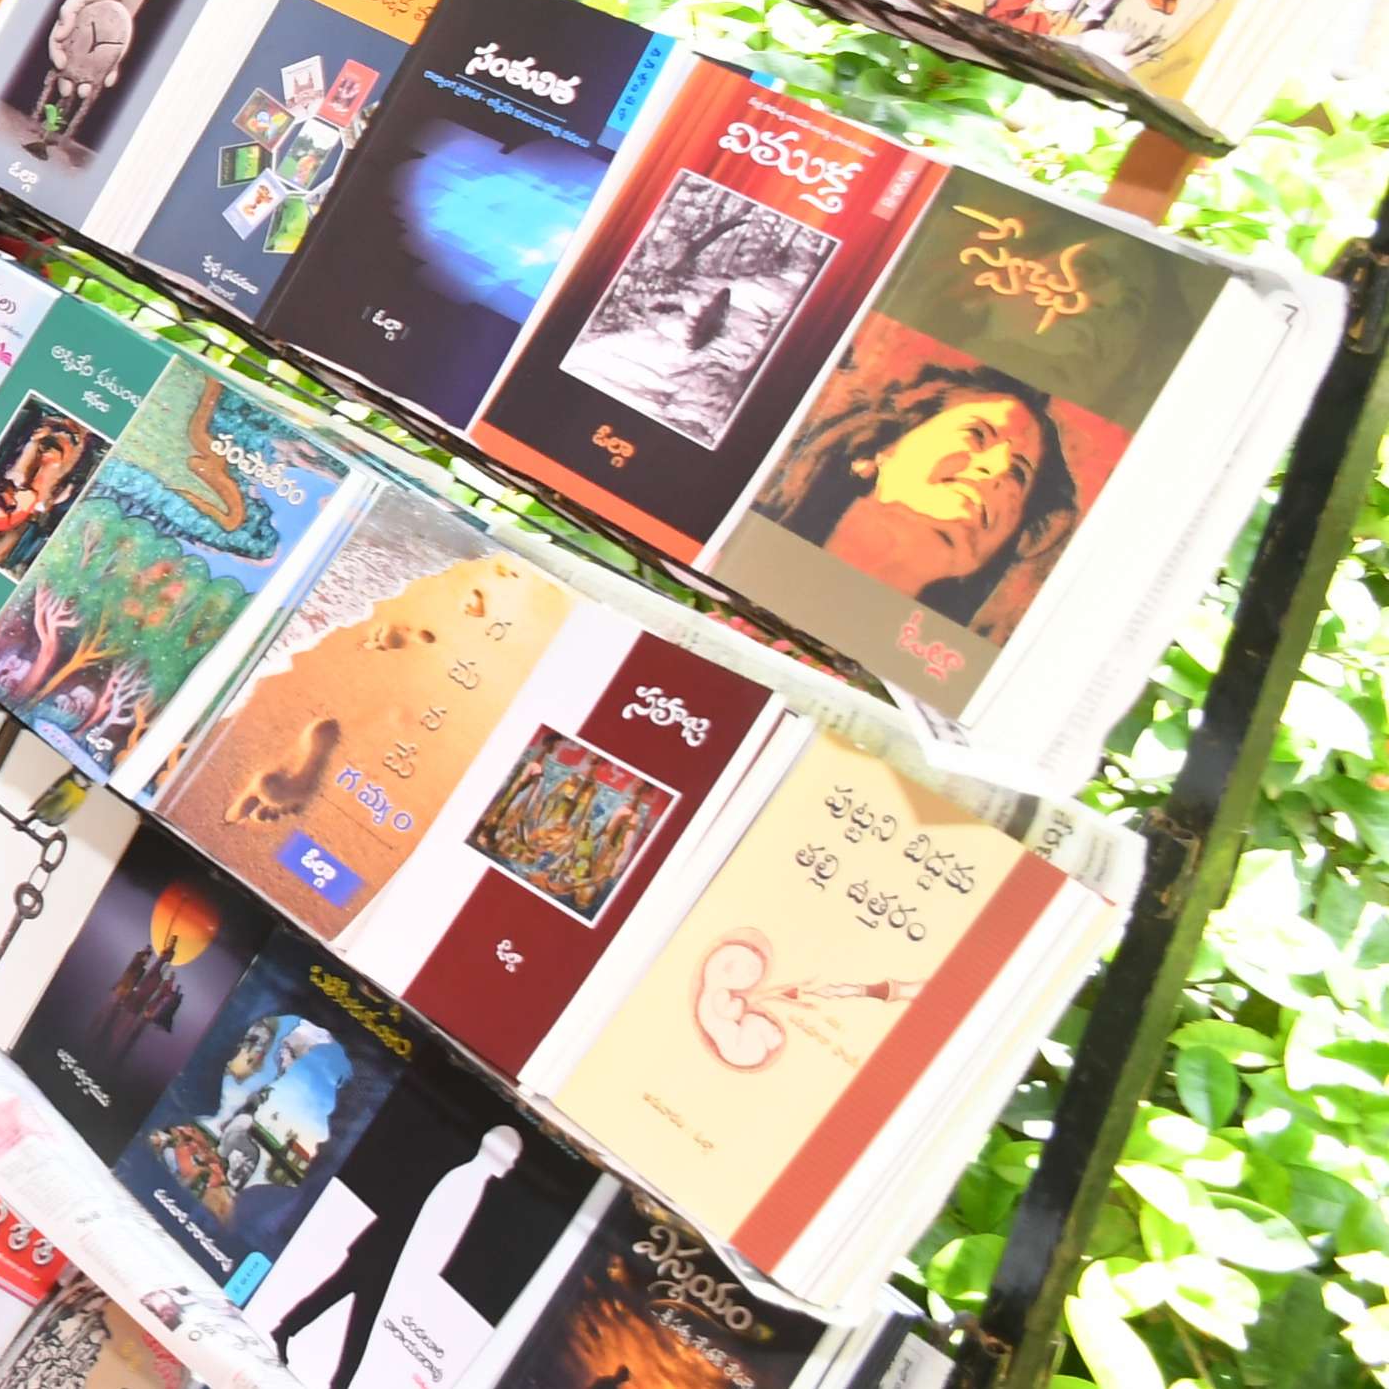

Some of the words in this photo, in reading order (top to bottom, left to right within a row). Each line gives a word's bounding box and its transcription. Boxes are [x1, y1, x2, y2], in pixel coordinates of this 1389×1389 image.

[8, 161, 39, 193] ఓల్గా
[719, 120, 864, 214] విముక్త
[372, 309, 404, 340] ఓల్గా
[211, 434, 306, 506] పంపాతీరం
[591, 426, 635, 471] ఓల్గా
[897, 612, 965, 683] ఓల్గా
[336, 765, 415, 834] గమ్యం
[824, 784, 898, 844] పుట్టని
[300, 847, 339, 889] ఓల్గా
[795, 842, 840, 891] తల్లి
[845, 876, 928, 943] ఉత్తరం
[632, 1223, 753, 1332] విస్మయం
